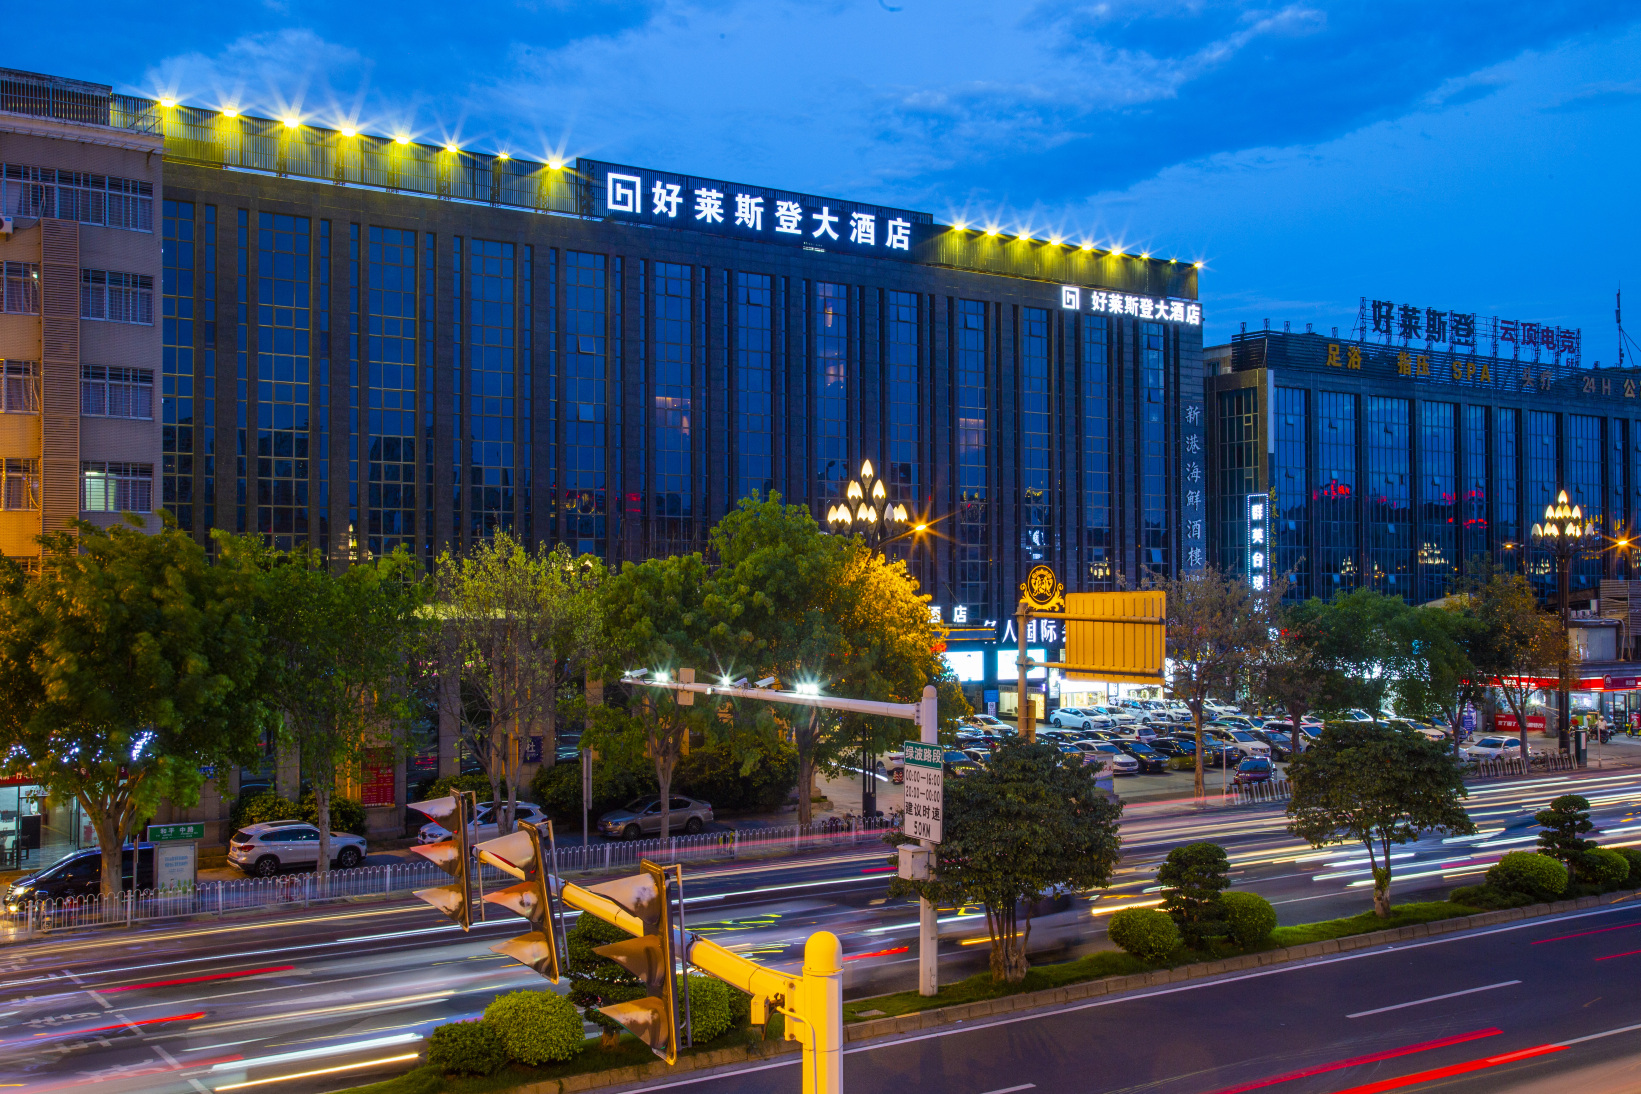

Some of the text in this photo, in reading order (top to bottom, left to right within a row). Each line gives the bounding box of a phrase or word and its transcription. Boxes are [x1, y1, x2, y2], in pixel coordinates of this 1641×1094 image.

[651, 180, 911, 250] 好莱斯登大酒店
[1091, 290, 1201, 326] 好莱斯登大酒店
[1371, 300, 1576, 355] 好莱斯登 云顶电竞
[1326, 343, 1363, 370] 足浴
[1397, 351, 1432, 377] 指压
[1452, 360, 1491, 383] SPA
[1521, 368, 1552, 391] 头疗
[1623, 377, 1641, 399] 公
[905, 745, 942, 764] 绿波路段
[905, 801, 941, 822] 建议时速
[913, 820, 931, 839] 50KM
